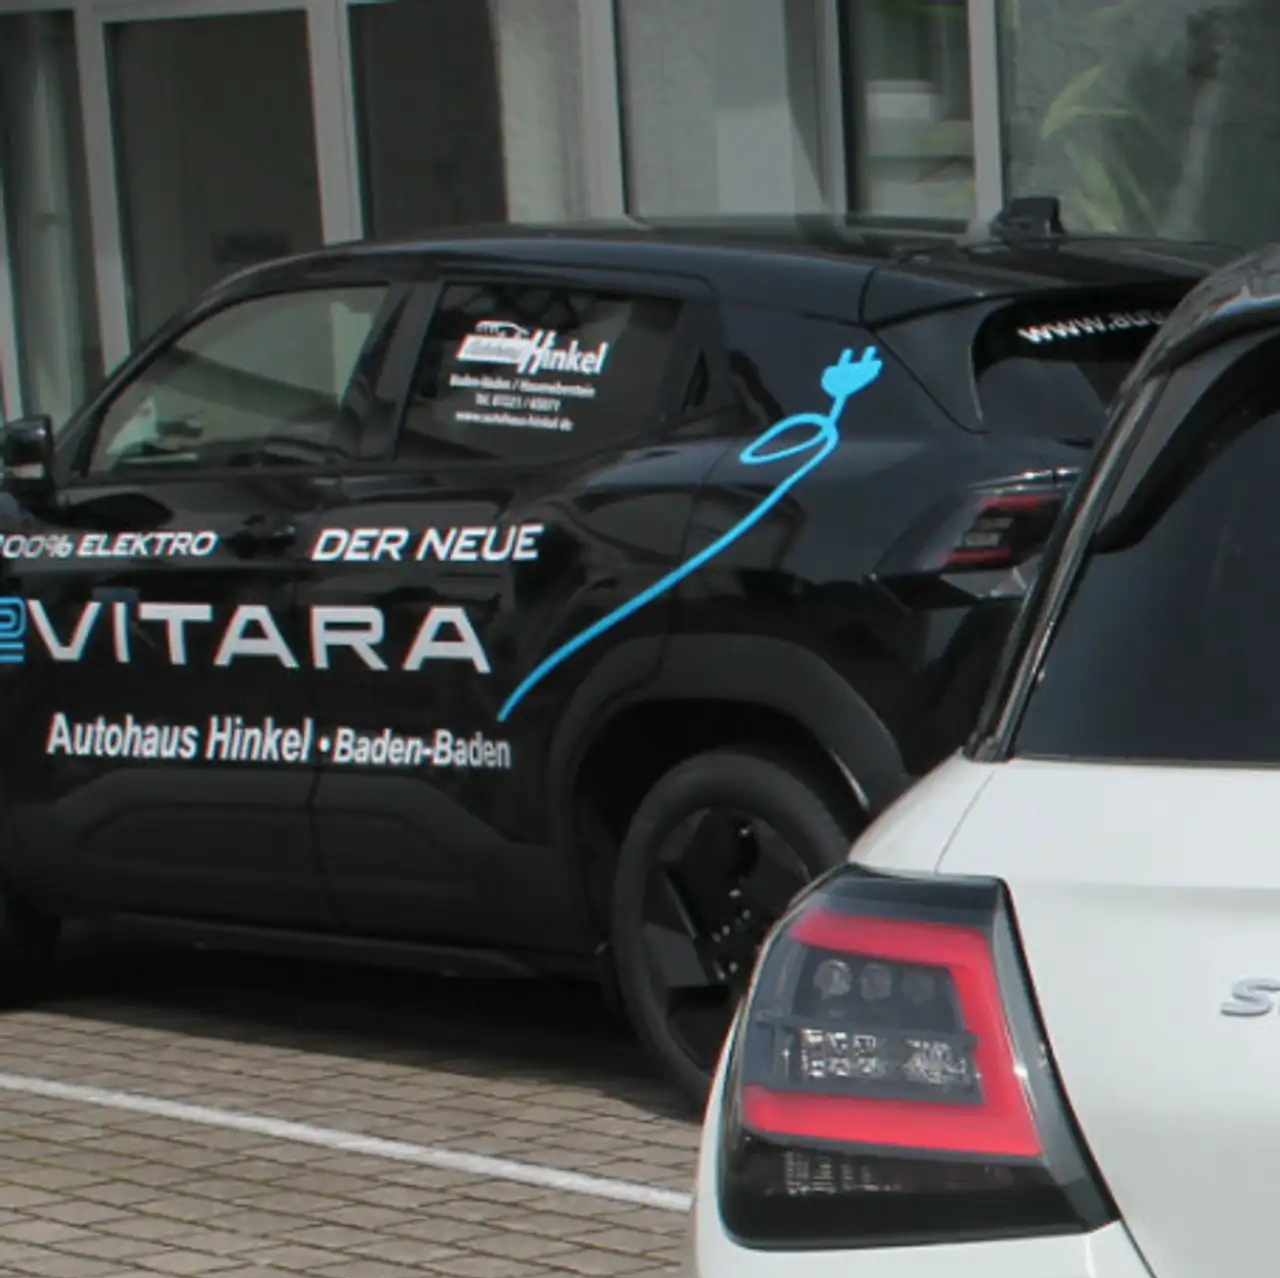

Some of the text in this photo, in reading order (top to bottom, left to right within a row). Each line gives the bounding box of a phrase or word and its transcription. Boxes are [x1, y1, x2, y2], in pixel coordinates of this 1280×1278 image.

[515, 328, 609, 375] Hinkel
[77, 531, 219, 556] ELEKTRO
[311, 523, 545, 561] DER NEUE
[46, 711, 512, 768] Autohaus Hinkel Baden-Baden
